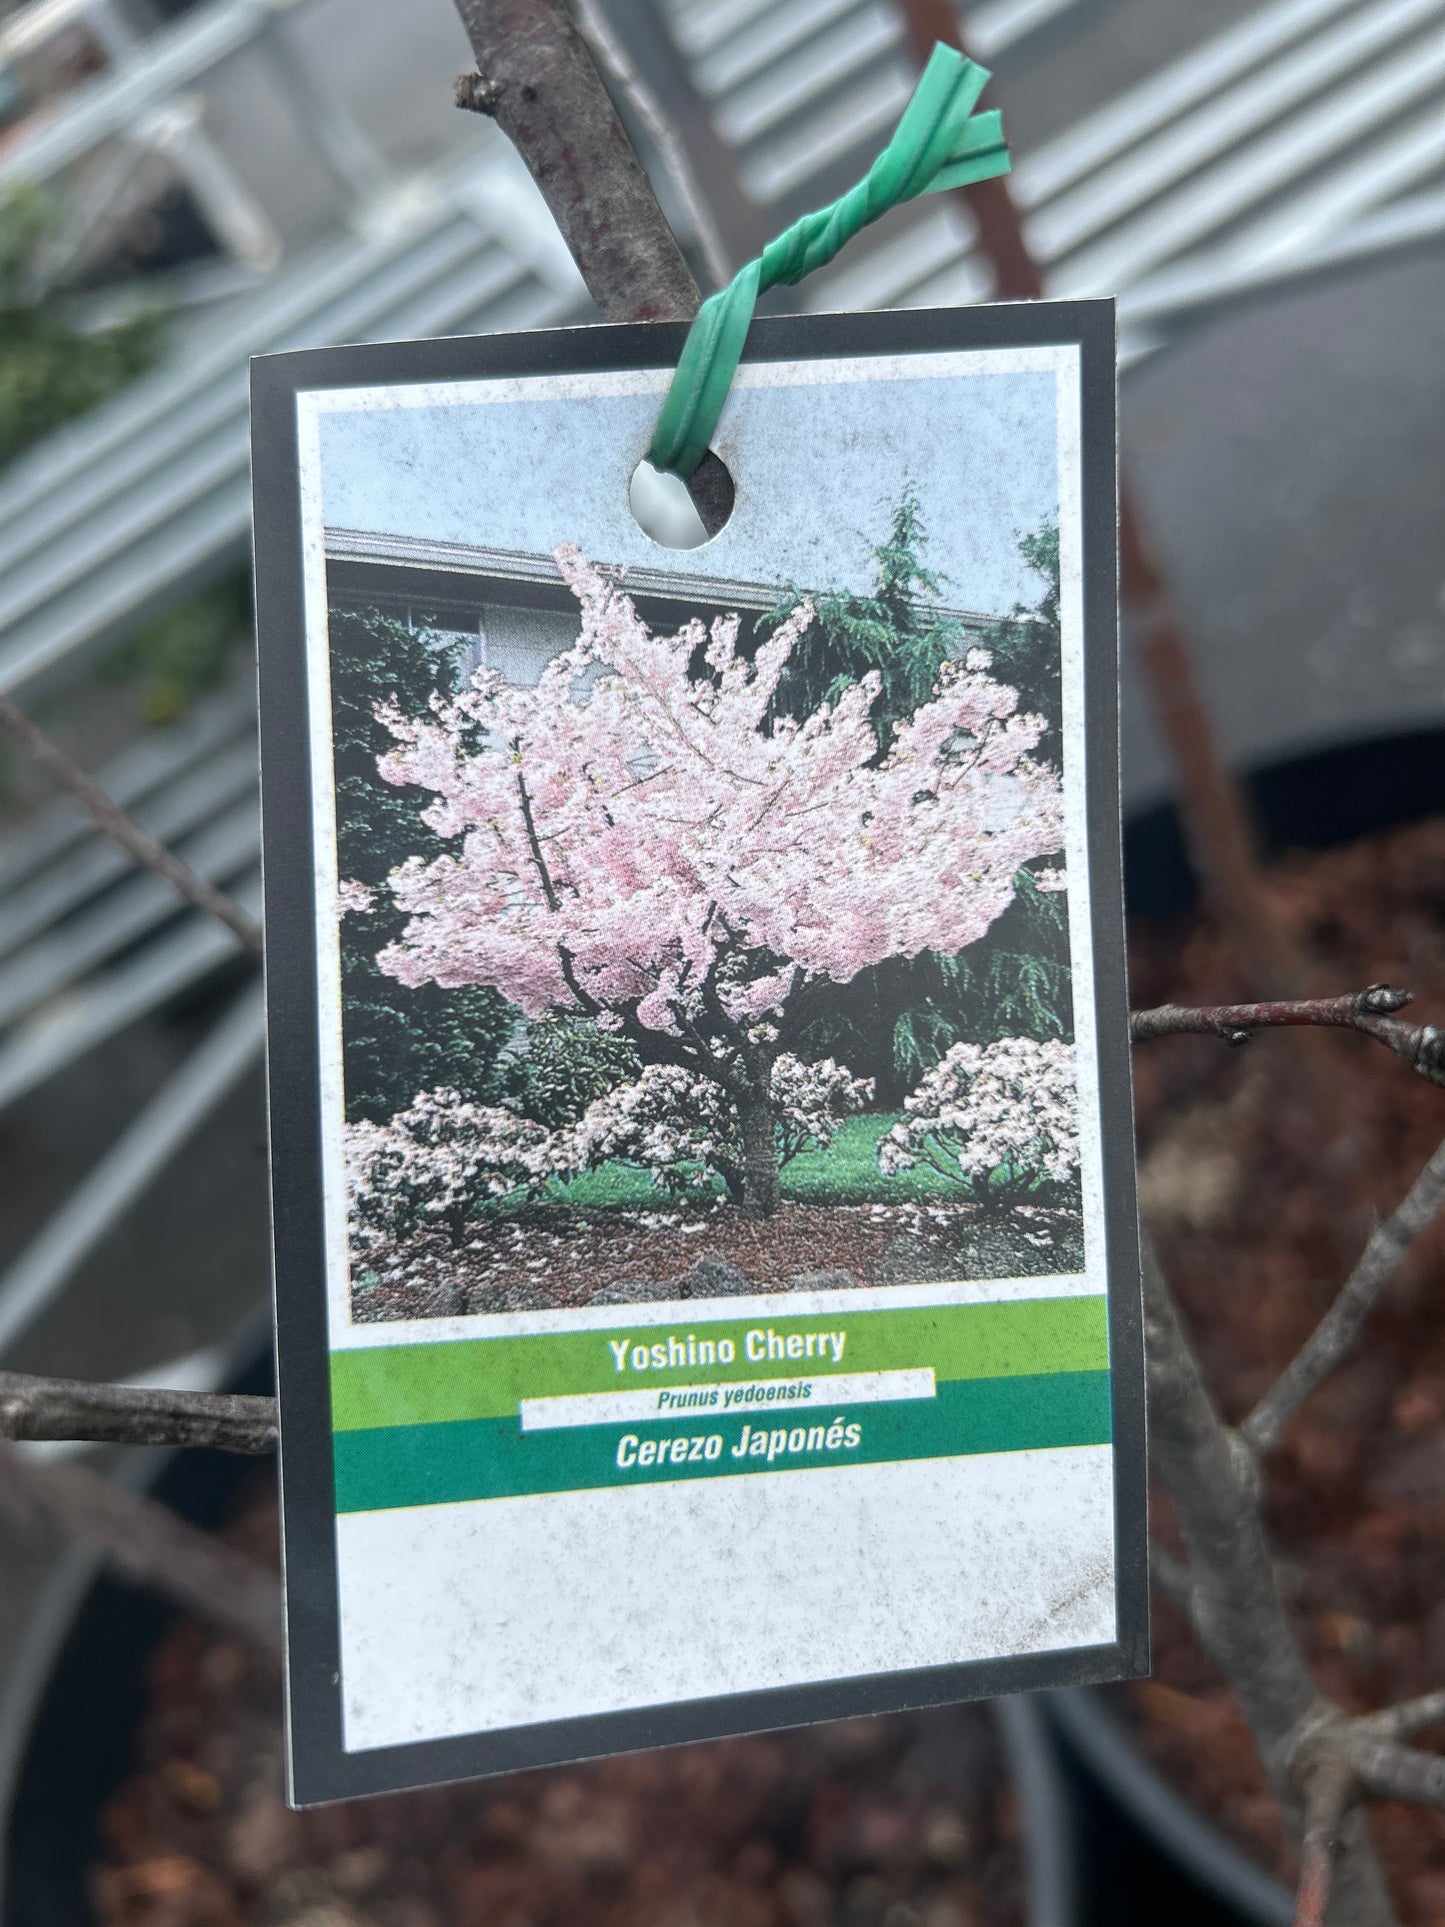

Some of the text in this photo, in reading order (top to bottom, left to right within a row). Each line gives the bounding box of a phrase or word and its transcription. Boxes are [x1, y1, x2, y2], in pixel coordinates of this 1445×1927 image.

[608, 1328, 847, 1372] Yoshino Cherry
[657, 1381, 813, 1409] Prunus yedoensis
[616, 1416, 862, 1468] Cerezo Japonés
